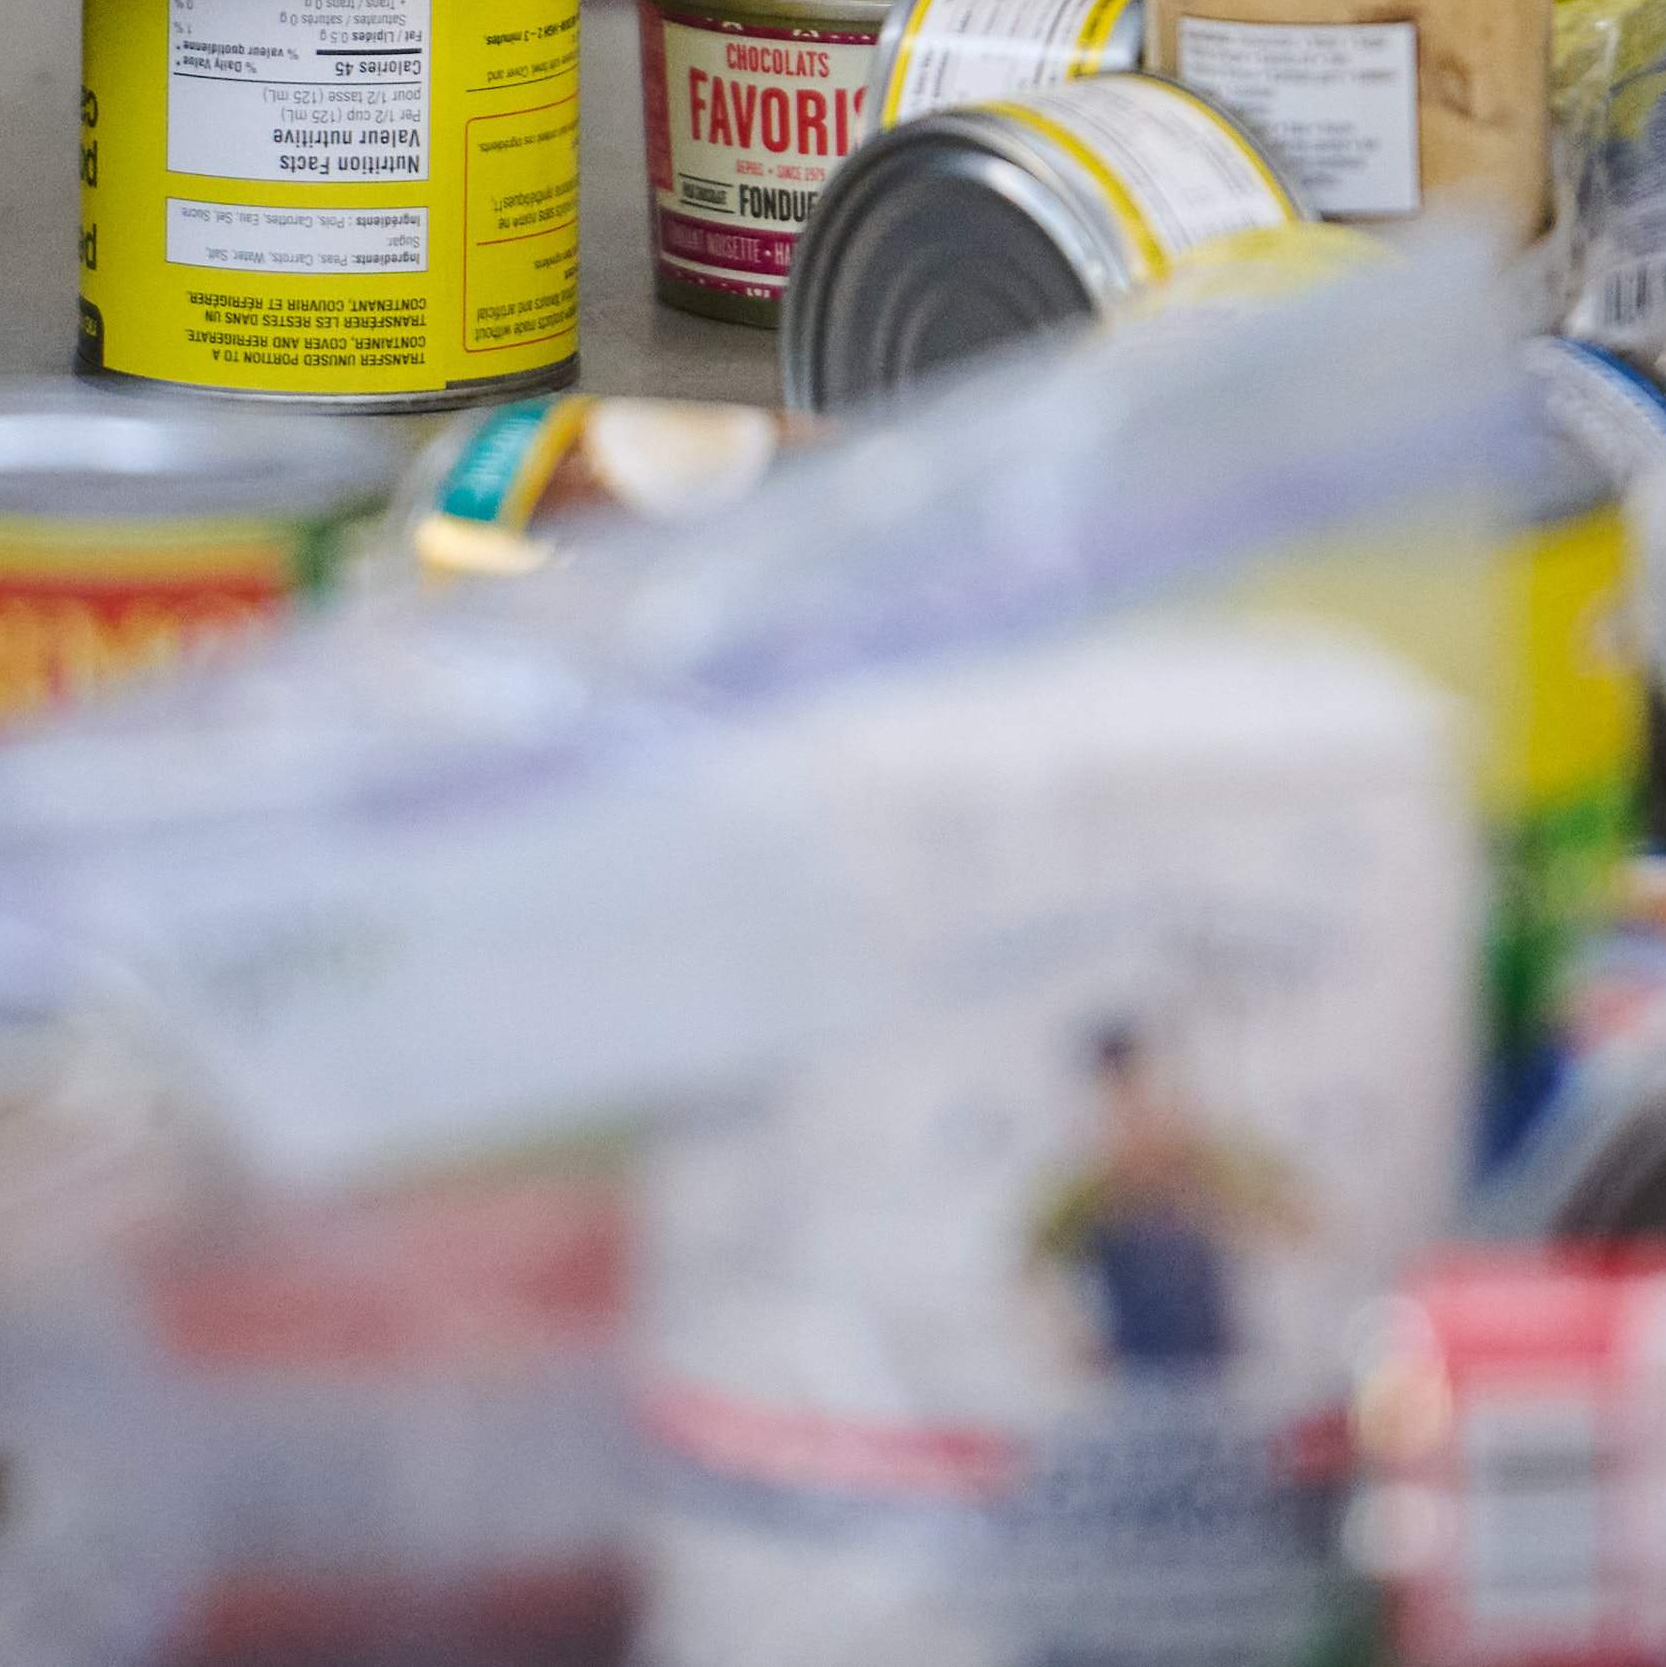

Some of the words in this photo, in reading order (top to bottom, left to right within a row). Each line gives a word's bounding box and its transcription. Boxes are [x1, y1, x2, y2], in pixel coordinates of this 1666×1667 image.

[302, 13, 343, 25] saturés
[353, 14, 406, 26] Saturates
[330, 32, 349, 43] 0.5
[352, 30, 394, 43] Lipides
[405, 30, 421, 42] Fat
[249, 46, 284, 58] valeur
[214, 57, 242, 72] Daily
[725, 42, 830, 79] CHOCOLATS
[336, 62, 354, 76] 45
[360, 60, 421, 76] Calories
[487, 70, 504, 83] and
[263, 87, 289, 103] mL)
[293, 89, 324, 104] (125
[329, 90, 362, 102] tasse
[367, 90, 387, 103] 1/2
[393, 88, 421, 101] pour
[281, 108, 307, 122] mL)
[312, 109, 342, 123] (125
[347, 109, 371, 121] cup
[376, 109, 396, 122] 1/2
[400, 109, 421, 122] Per
[273, 128, 352, 147] nutritive
[359, 129, 420, 148] Valeur
[280, 155, 330, 174] Facts
[338, 155, 420, 174] Nutrition
[263, 214, 313, 226] Carottes,
[317, 216, 345, 228] Pois,
[356, 213, 420, 228] Ingrédients
[269, 252, 313, 264] Carrots,
[317, 253, 348, 266] Peas,
[352, 252, 420, 265] Ingredients:
[186, 291, 263, 310] RÉFRIGÉRER.
[268, 299, 282, 310] ET
[288, 299, 343, 311] COUVRIR
[348, 298, 426, 311] CONTENANT,
[205, 311, 221, 322] UN
[225, 312, 258, 325] DANS
[263, 315, 311, 328] RESTES
[317, 317, 339, 328] LES
[344, 315, 425, 329] TRANSFÉRER
[185, 329, 268, 346] REFRIGERATE.
[273, 337, 299, 348] AND
[305, 338, 346, 349] COVER
[351, 336, 426, 349] CONTAINER,
[212, 349, 219, 360] A
[225, 351, 238, 363] TO
[244, 352, 298, 364] PORTION
[304, 354, 355, 365] UNUSED
[361, 352, 425, 365] TRANSFER
